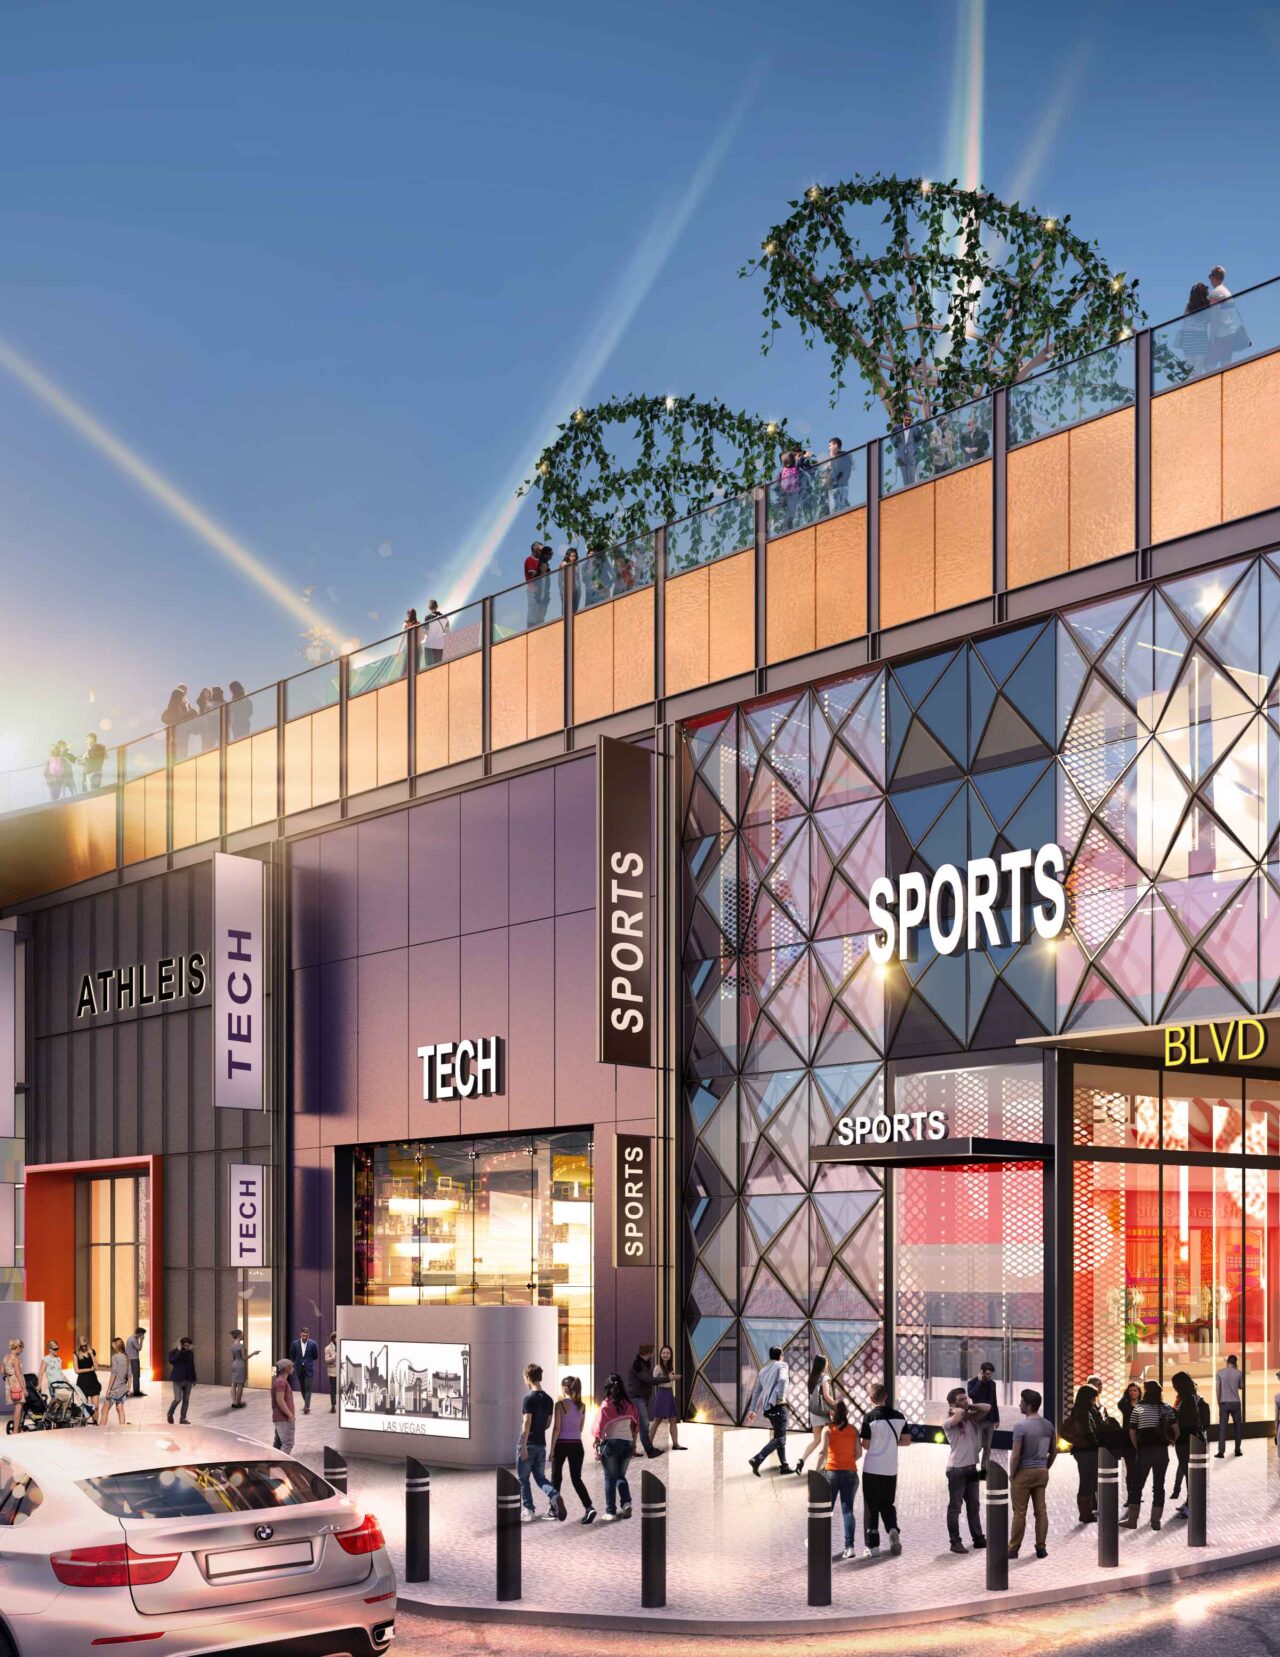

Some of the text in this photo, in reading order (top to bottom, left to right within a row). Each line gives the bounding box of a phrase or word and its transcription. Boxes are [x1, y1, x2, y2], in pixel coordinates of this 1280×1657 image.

[868, 843, 1066, 965] SPORTS
[610, 851, 643, 1034] SPORTS
[76, 951, 212, 1018] ATHLEIS
[227, 928, 252, 1080] TECH
[418, 1036, 500, 1100] TECH
[1164, 1018, 1266, 1066] BLVD
[838, 1110, 946, 1146] SPORTS
[239, 1179, 257, 1258] TECH
[625, 1145, 643, 1257] SPORTS
[382, 1420, 427, 1434] LAS VEGAS
